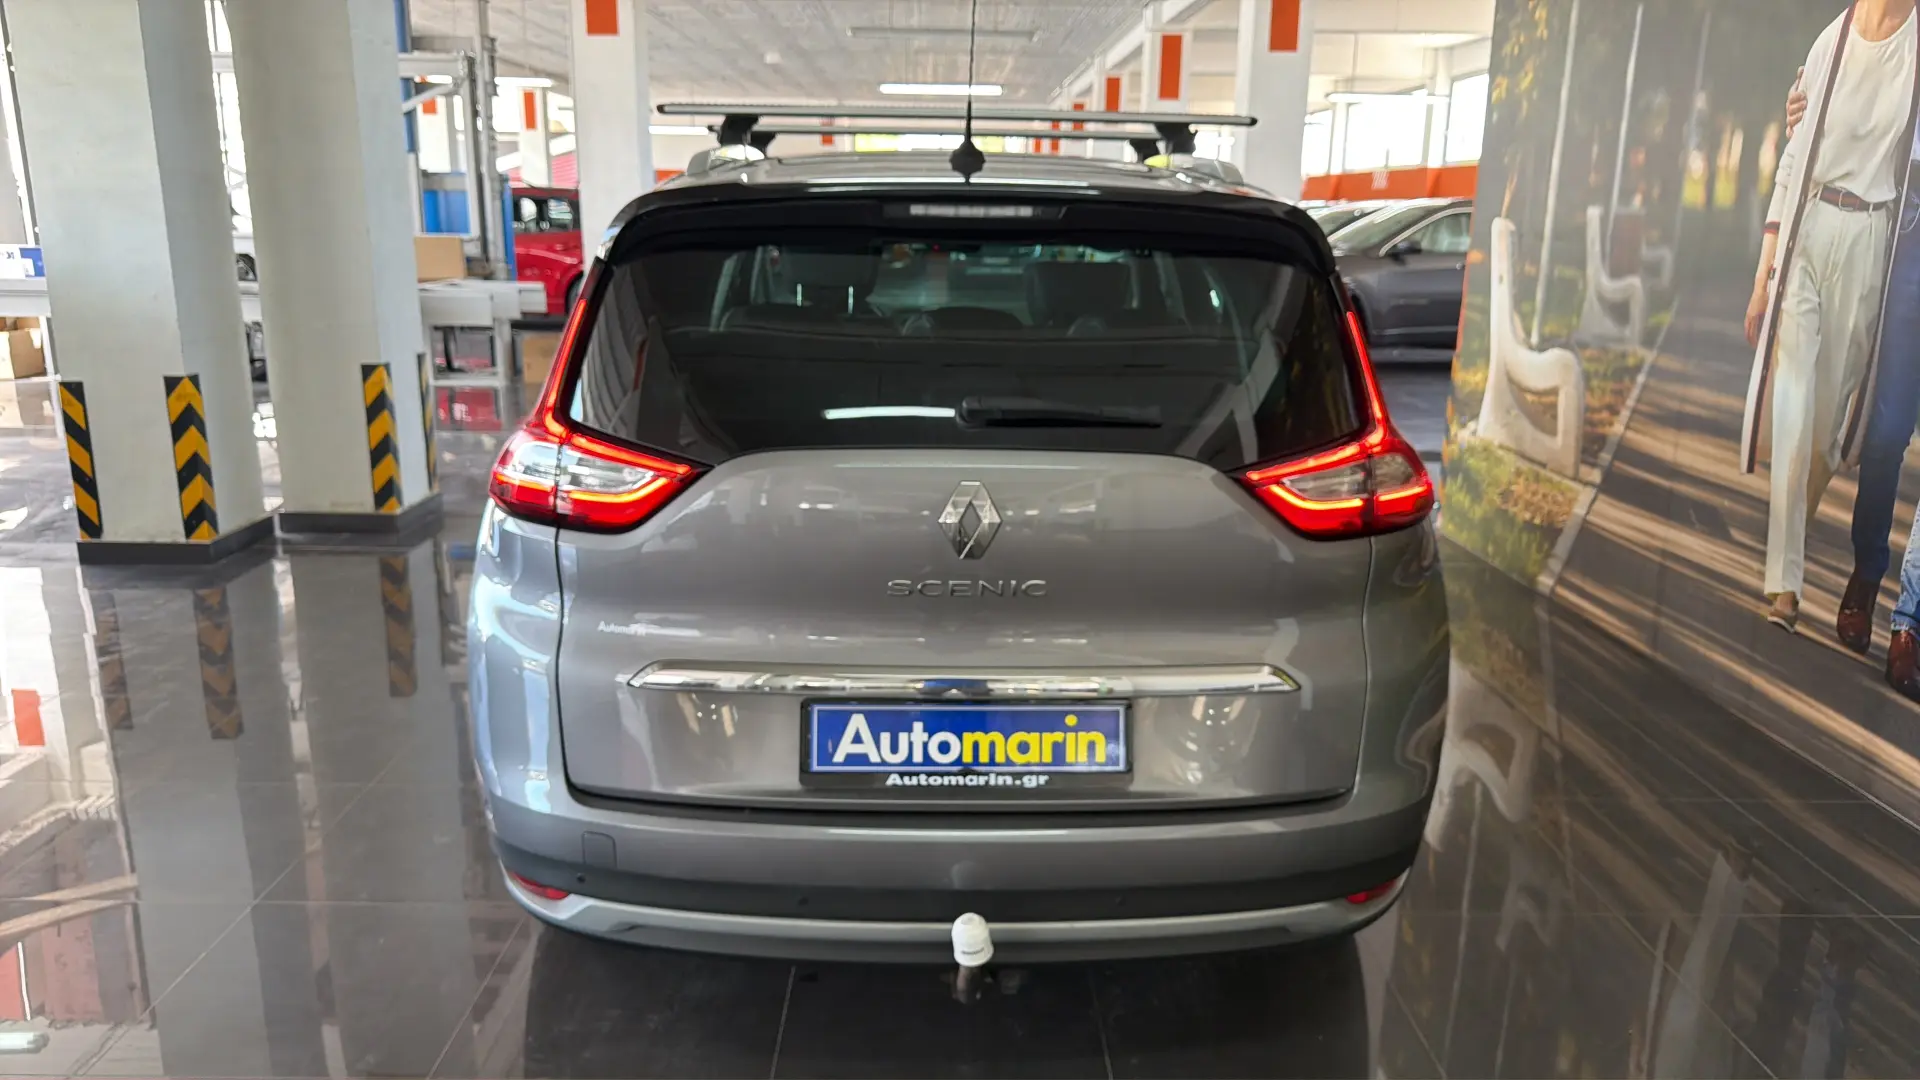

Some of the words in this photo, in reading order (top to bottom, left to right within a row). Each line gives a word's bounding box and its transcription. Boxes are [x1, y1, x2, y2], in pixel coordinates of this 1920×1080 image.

[887, 579, 1047, 597] SCENIC
[597, 620, 646, 637] Automn
[832, 713, 1107, 764] Automarin
[886, 772, 1049, 788] Automarin.gr
